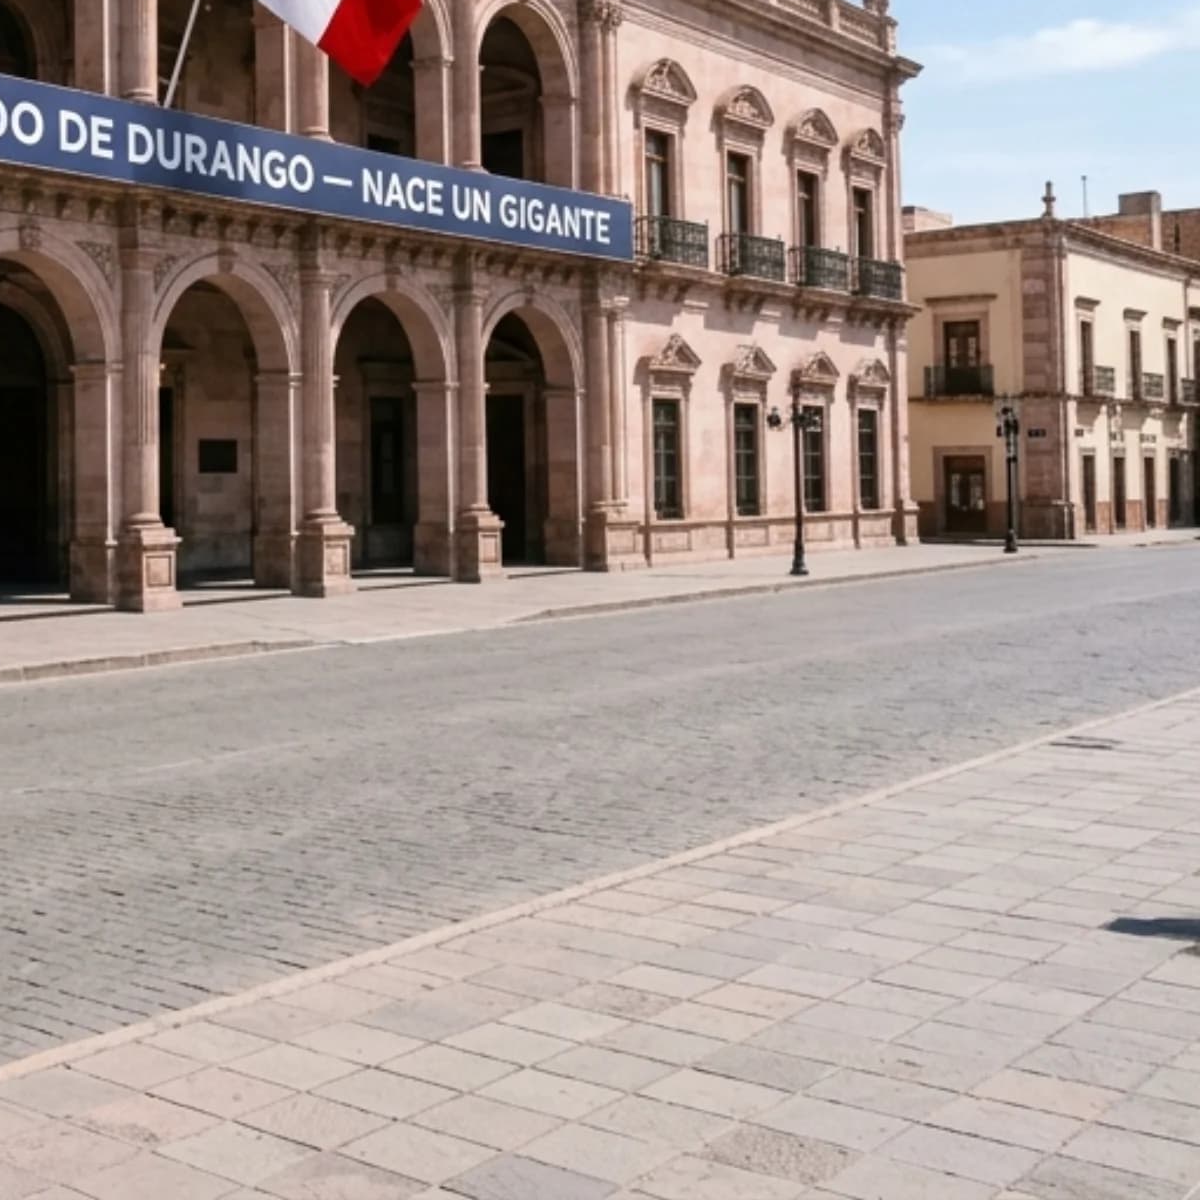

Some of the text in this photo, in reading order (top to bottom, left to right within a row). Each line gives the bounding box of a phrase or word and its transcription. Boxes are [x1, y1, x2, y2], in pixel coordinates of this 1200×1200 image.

[58, 109, 115, 160] DE
[127, 122, 315, 193] DURANGO
[361, 167, 444, 217] NACE
[451, 183, 492, 224] UN
[498, 193, 611, 245] GIGANTE
